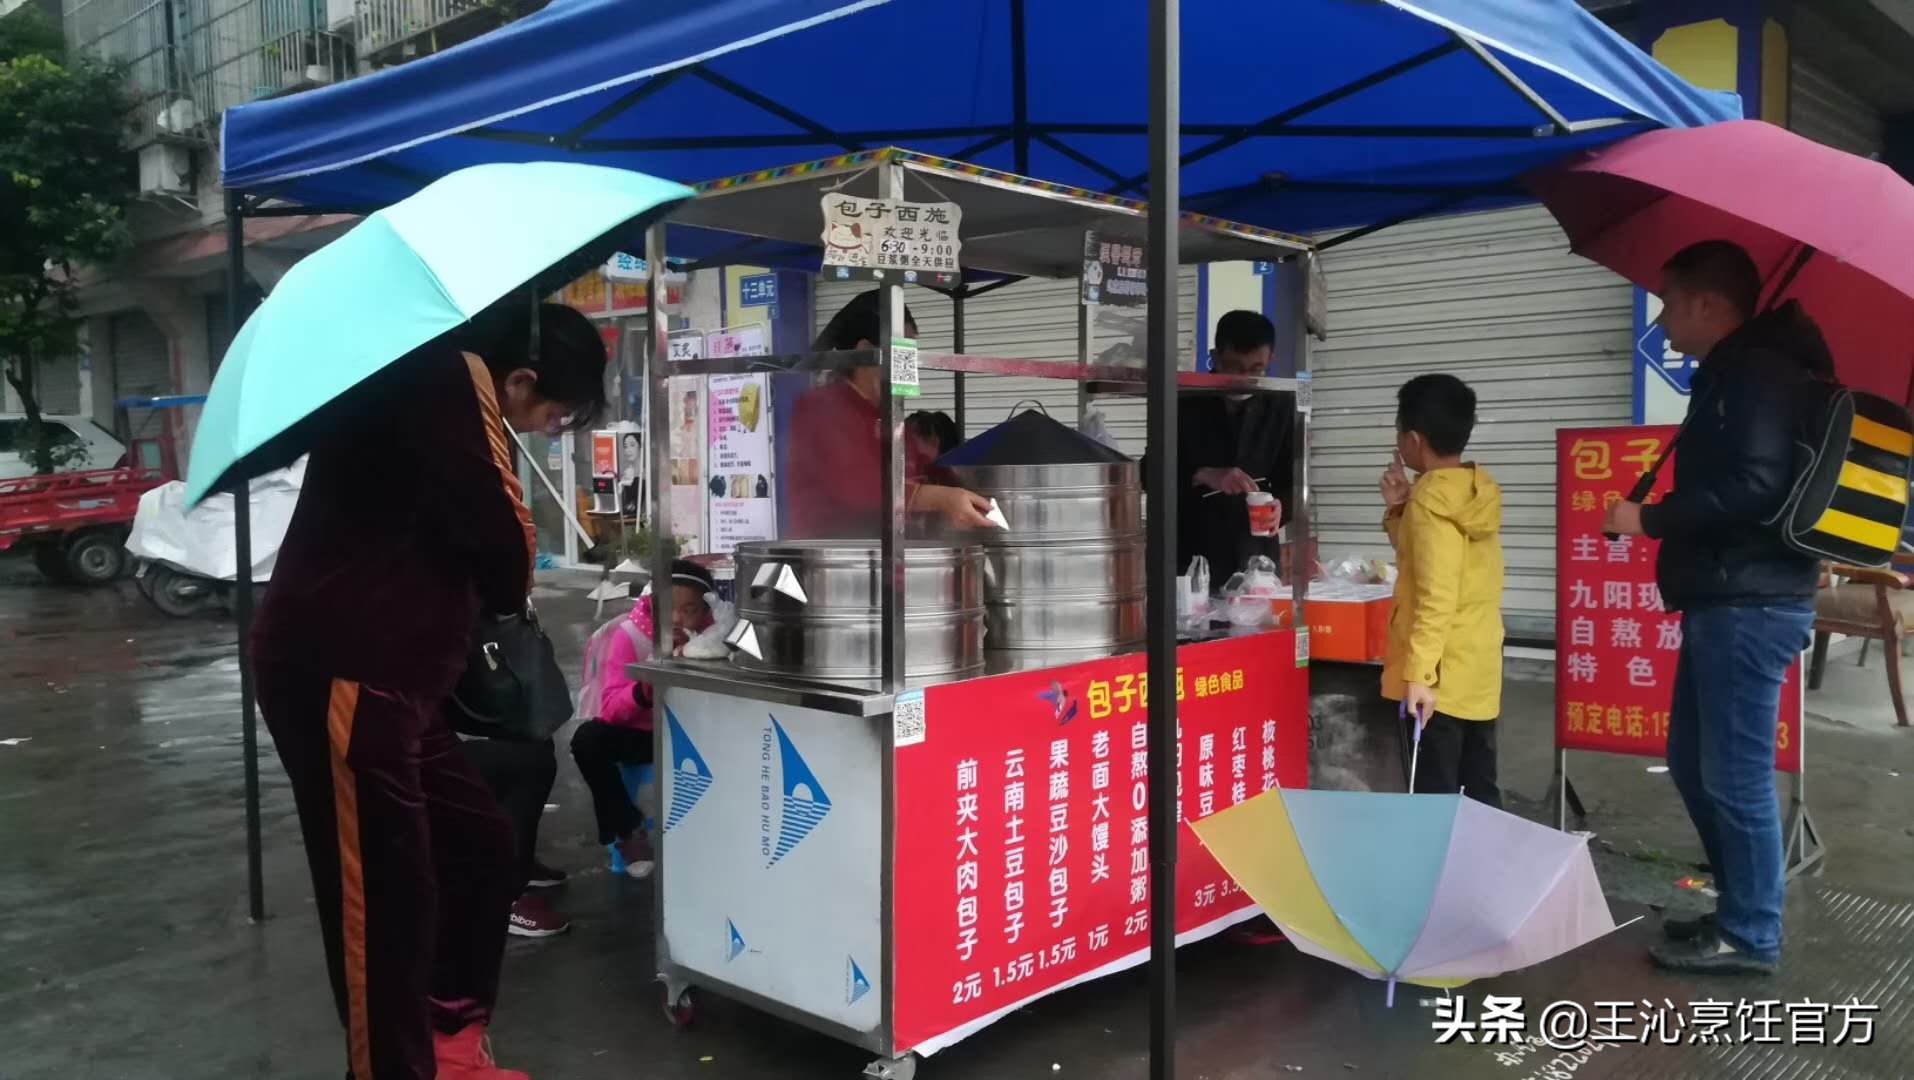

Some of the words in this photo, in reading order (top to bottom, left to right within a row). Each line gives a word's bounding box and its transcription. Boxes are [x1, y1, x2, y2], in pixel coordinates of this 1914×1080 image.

[835, 200, 950, 225] 包子西施
[884, 225, 949, 242] 欢迎光临
[742, 280, 775, 300] 十三单元
[1570, 438, 1661, 480] 包子
[1194, 669, 1243, 698] 绿色食品
[762, 727, 773, 761] TONG
[761, 765, 771, 782] HE
[761, 785, 770, 811] BAO
[1091, 730, 1110, 884] 老面大馒头
[761, 815, 771, 832] HU
[1049, 739, 1069, 928] 果蔬豆沙包子
[761, 835, 771, 857] MO
[956, 758, 978, 961] 前夹大肉包子
[1004, 748, 1025, 944] 云南土豆包子
[1194, 882, 1216, 907] 3元
[1124, 909, 1149, 936] 2元
[1088, 923, 1109, 951] 1元
[1039, 936, 1077, 969] 1.5元
[993, 952, 1035, 987] 1.5元
[953, 972, 982, 1004] 2元
